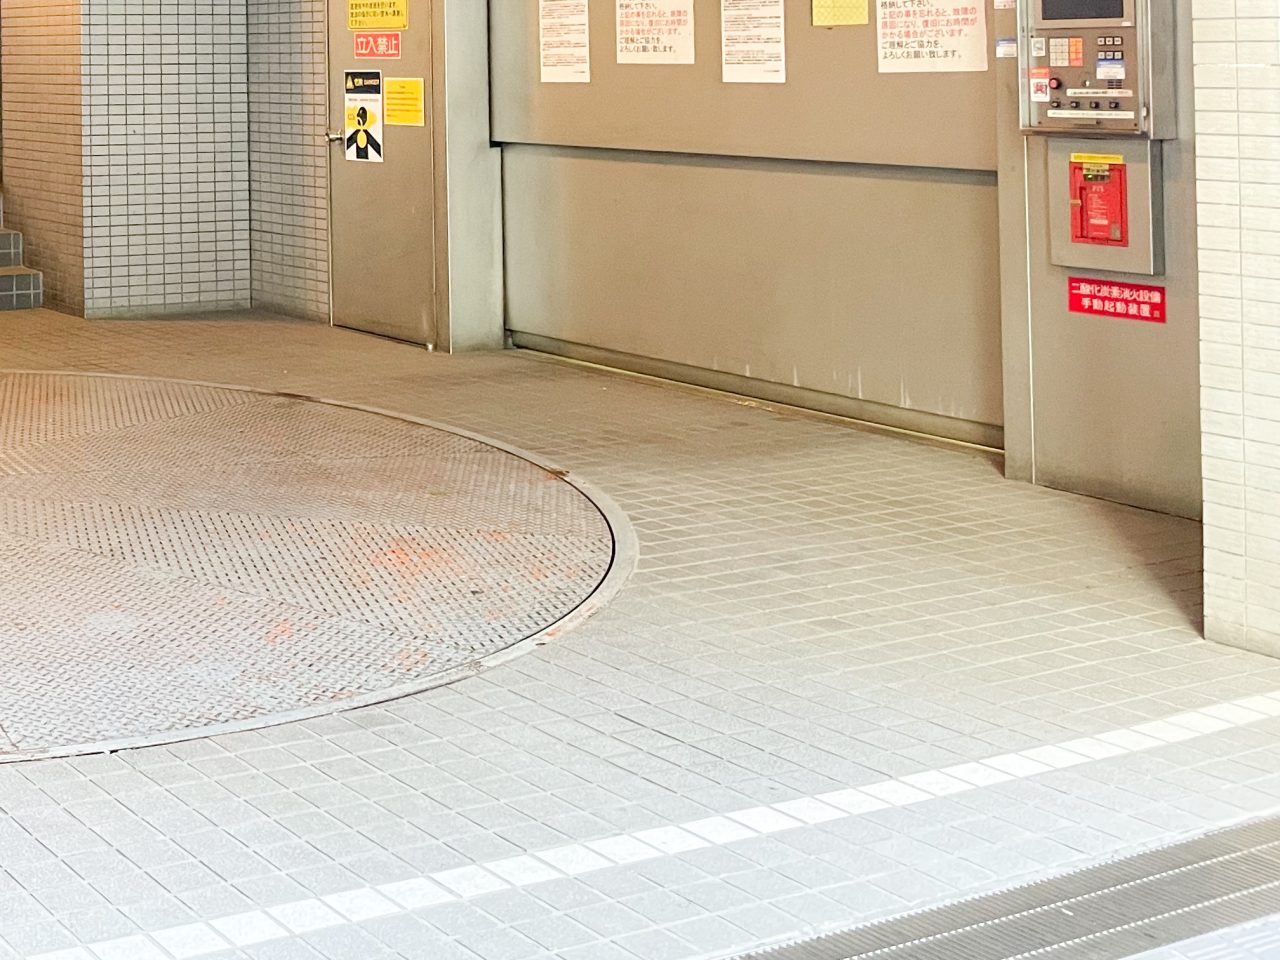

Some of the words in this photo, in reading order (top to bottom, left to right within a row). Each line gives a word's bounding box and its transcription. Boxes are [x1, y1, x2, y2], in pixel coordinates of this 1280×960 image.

[356, 37, 399, 54] 立入禁止
[882, 49, 962, 59] よろしくお願い致します。
[1072, 282, 1161, 304] 二酸化炭素消火設備
[1081, 298, 1151, 317] 手動起動装置
